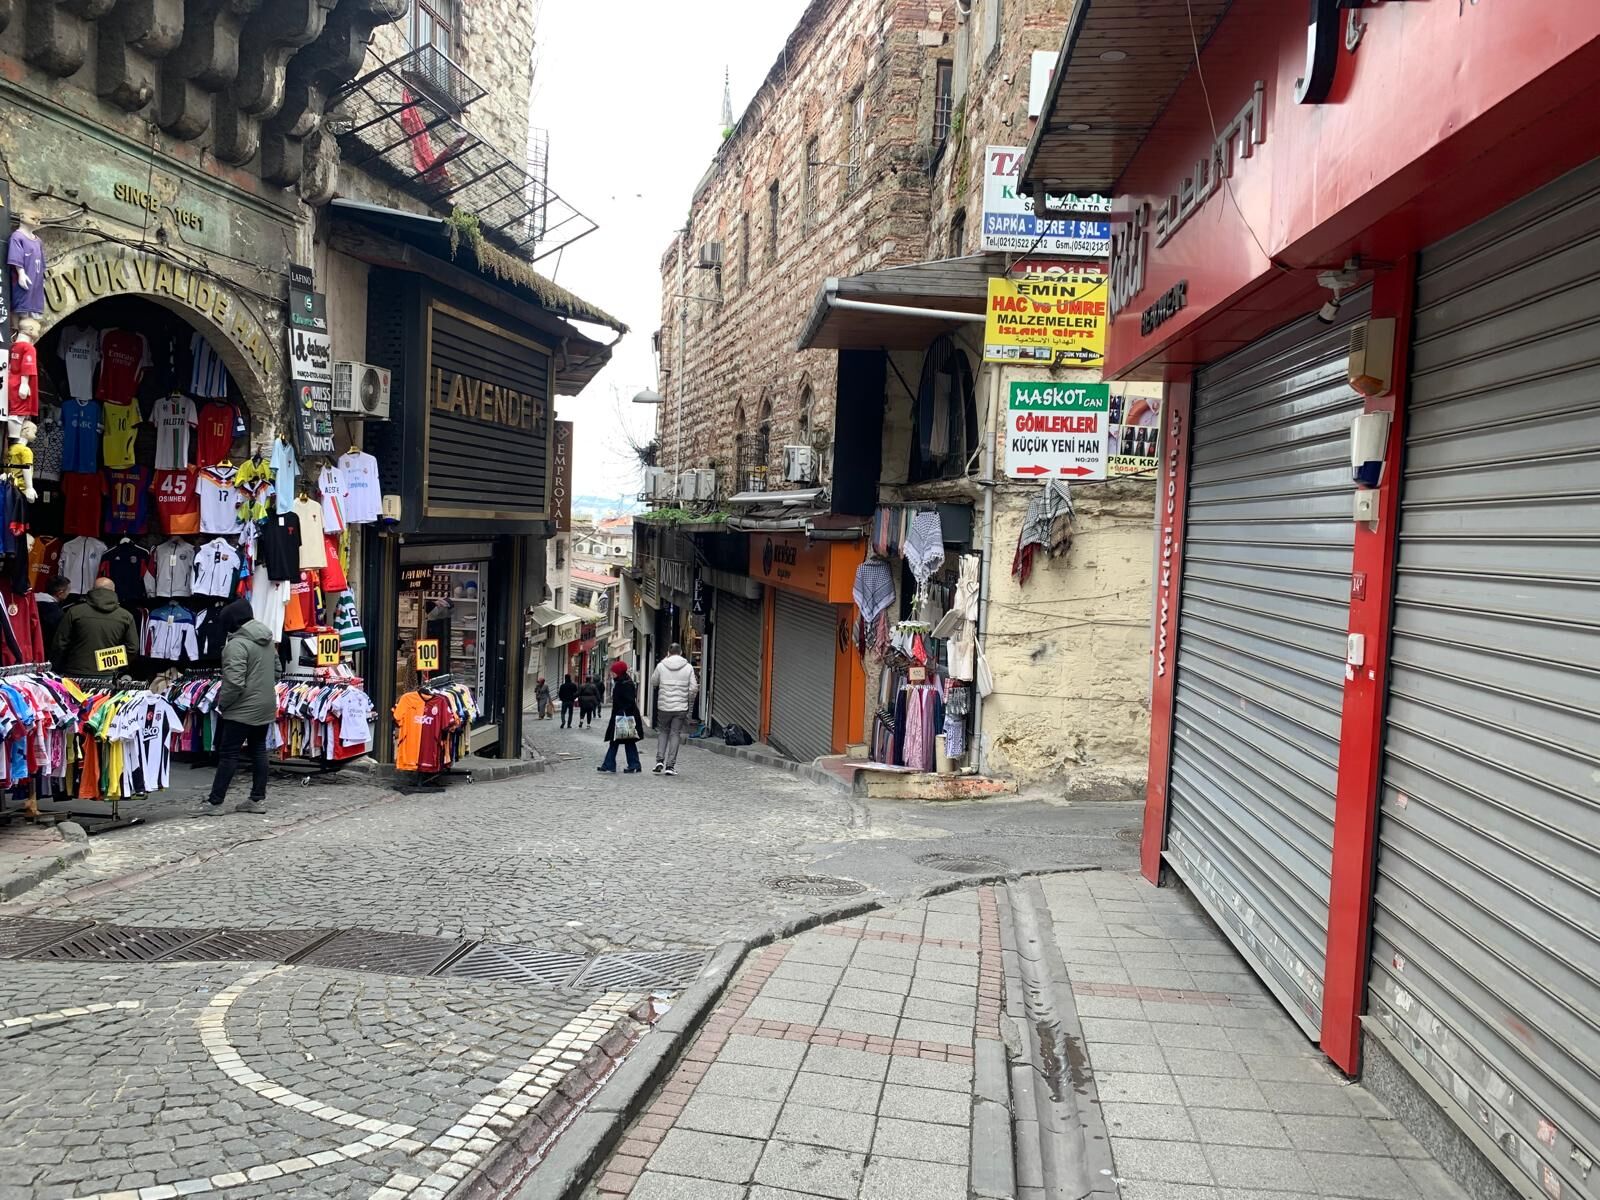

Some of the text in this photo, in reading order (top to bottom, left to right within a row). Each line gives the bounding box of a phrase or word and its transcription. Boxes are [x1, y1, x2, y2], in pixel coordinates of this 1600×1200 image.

[991, 153, 1023, 176] TA
[114, 183, 160, 213] SINCE
[988, 216, 1100, 238] ŞAPKA BERE ŞAL
[292, 271, 312, 286] LAFINO
[1017, 284, 1076, 297] EMİN
[43, 254, 129, 313] ÜYÜK
[134, 258, 228, 325] VALIDE
[231, 311, 272, 374] HAN
[992, 296, 1028, 312] HAC
[1032, 301, 1051, 313] ve
[997, 314, 1098, 328] MALZEMELERİ
[311, 386, 331, 401] MISS
[434, 367, 544, 433] LAVENDER
[1015, 388, 1103, 407] MASKOT CAN
[213, 422, 224, 436] 10
[1016, 412, 1098, 433] GÖMLEKLERİ
[1012, 436, 1099, 455] KÜÇÜK YENİ HAN
[161, 474, 187, 494] 45
[554, 443, 567, 529] EMPROYAL
[114, 482, 136, 506] 10
[219, 490, 229, 502] 17
[320, 638, 338, 654] 100
[478, 582, 486, 699] LAVENDER
[102, 655, 118, 668] 100
[418, 644, 437, 660] 100
